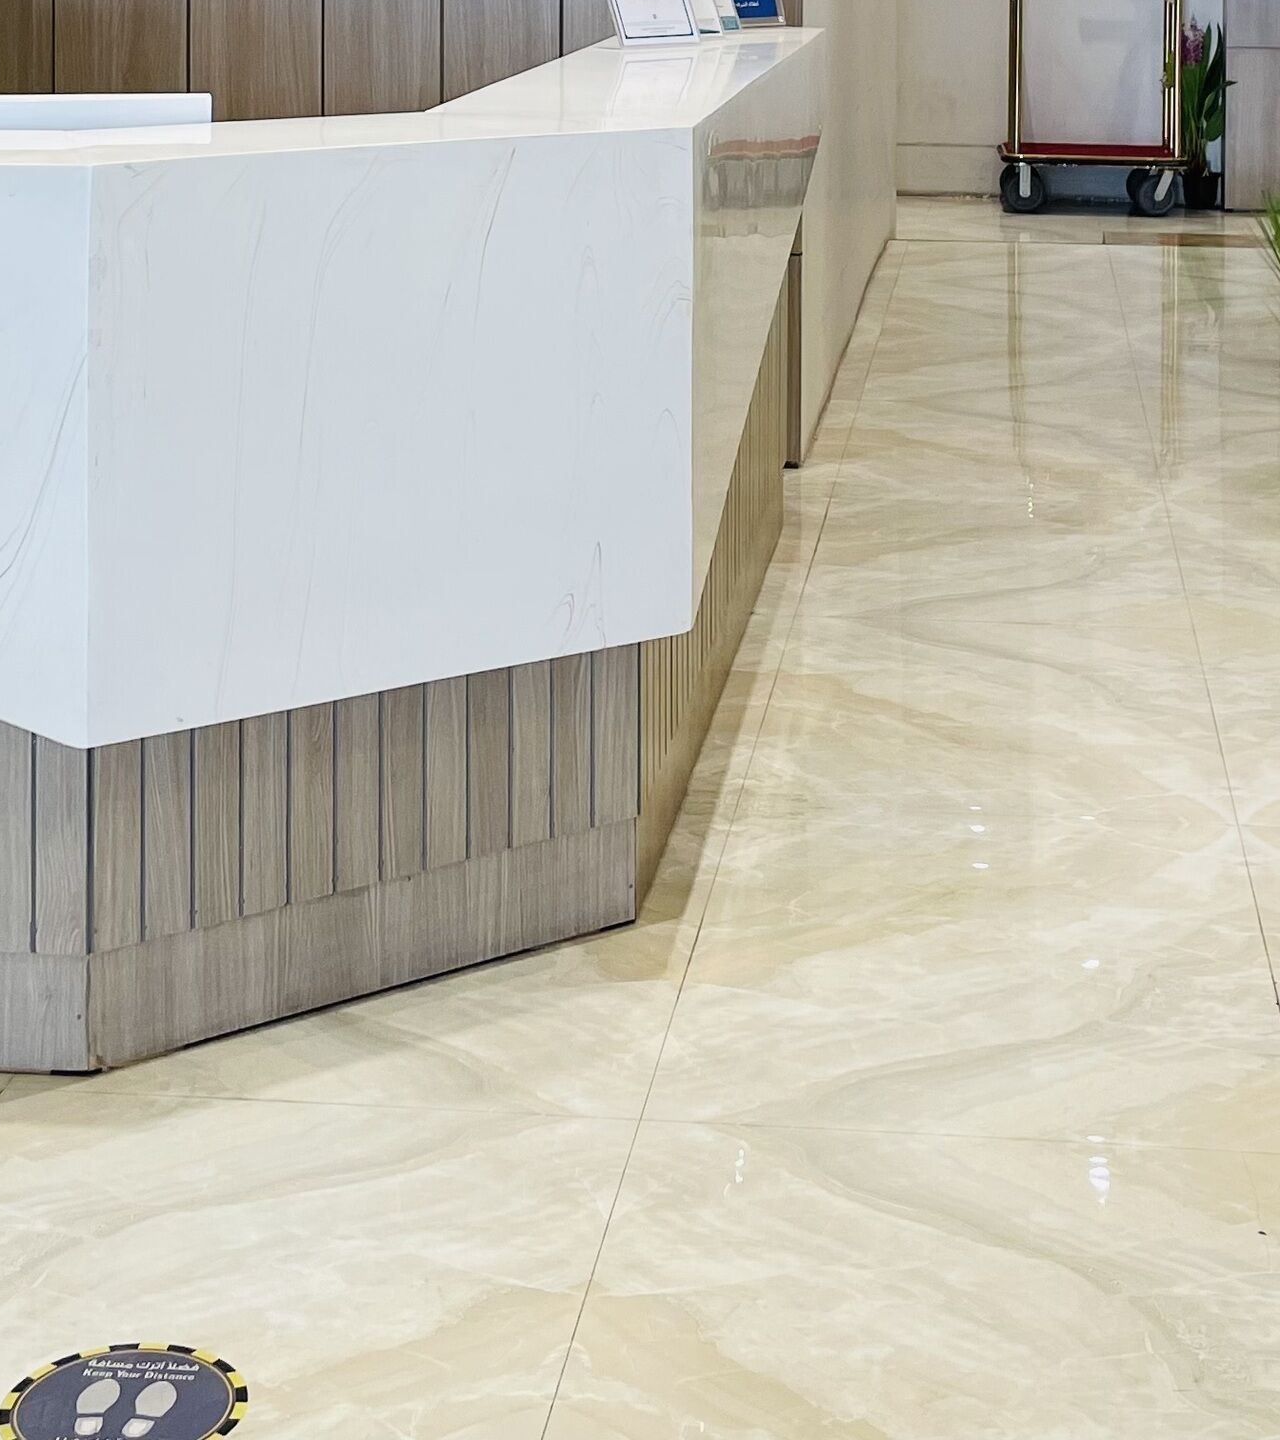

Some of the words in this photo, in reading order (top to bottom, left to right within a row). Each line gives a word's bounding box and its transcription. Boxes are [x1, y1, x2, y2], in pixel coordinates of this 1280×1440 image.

[82, 1368, 113, 1378] Keep
[117, 1369, 142, 1379] Your
[144, 1370, 195, 1381] Distance
